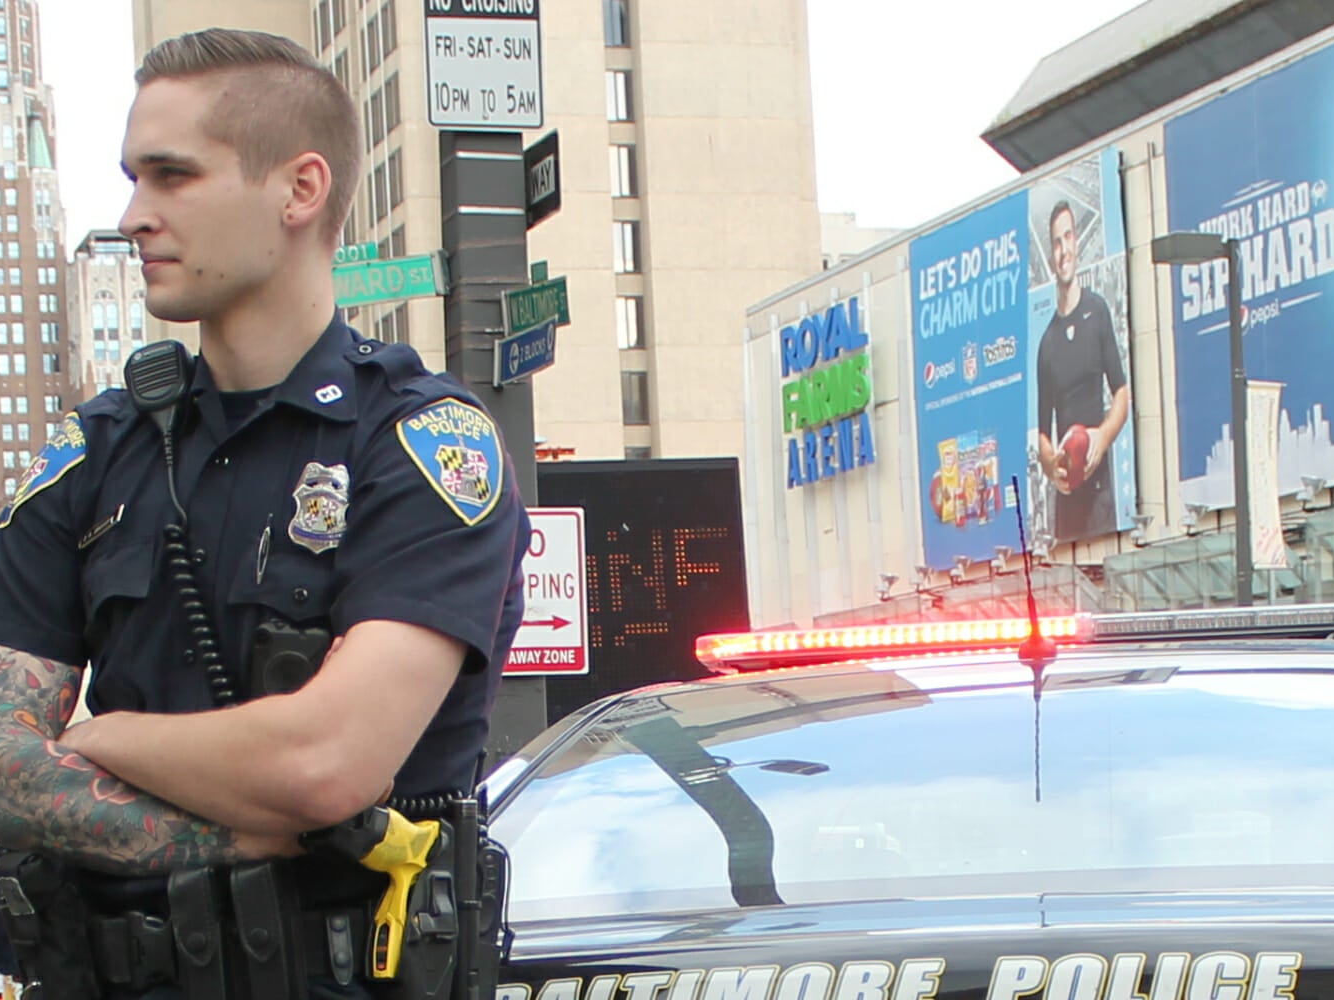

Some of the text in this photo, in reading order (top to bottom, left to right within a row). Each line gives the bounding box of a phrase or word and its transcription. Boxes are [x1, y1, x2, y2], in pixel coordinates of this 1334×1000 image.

[480, 88, 496, 113] TO
[531, 158, 552, 199] WAY
[1257, 181, 1310, 232] HARD
[333, 265, 405, 299] WARD
[918, 254, 957, 300] LET'S
[960, 246, 982, 279] DO
[919, 267, 1021, 340] CHARM CITY
[1250, 298, 1280, 328] pepsi
[780, 296, 869, 379] ROYAL
[781, 353, 873, 434] FARMS
[407, 405, 491, 437] BALTIMORE
[428, 419, 481, 440] POLICE
[786, 411, 876, 490] ARENA
[528, 573, 575, 600] PING
[543, 649, 576, 664] ZONE
